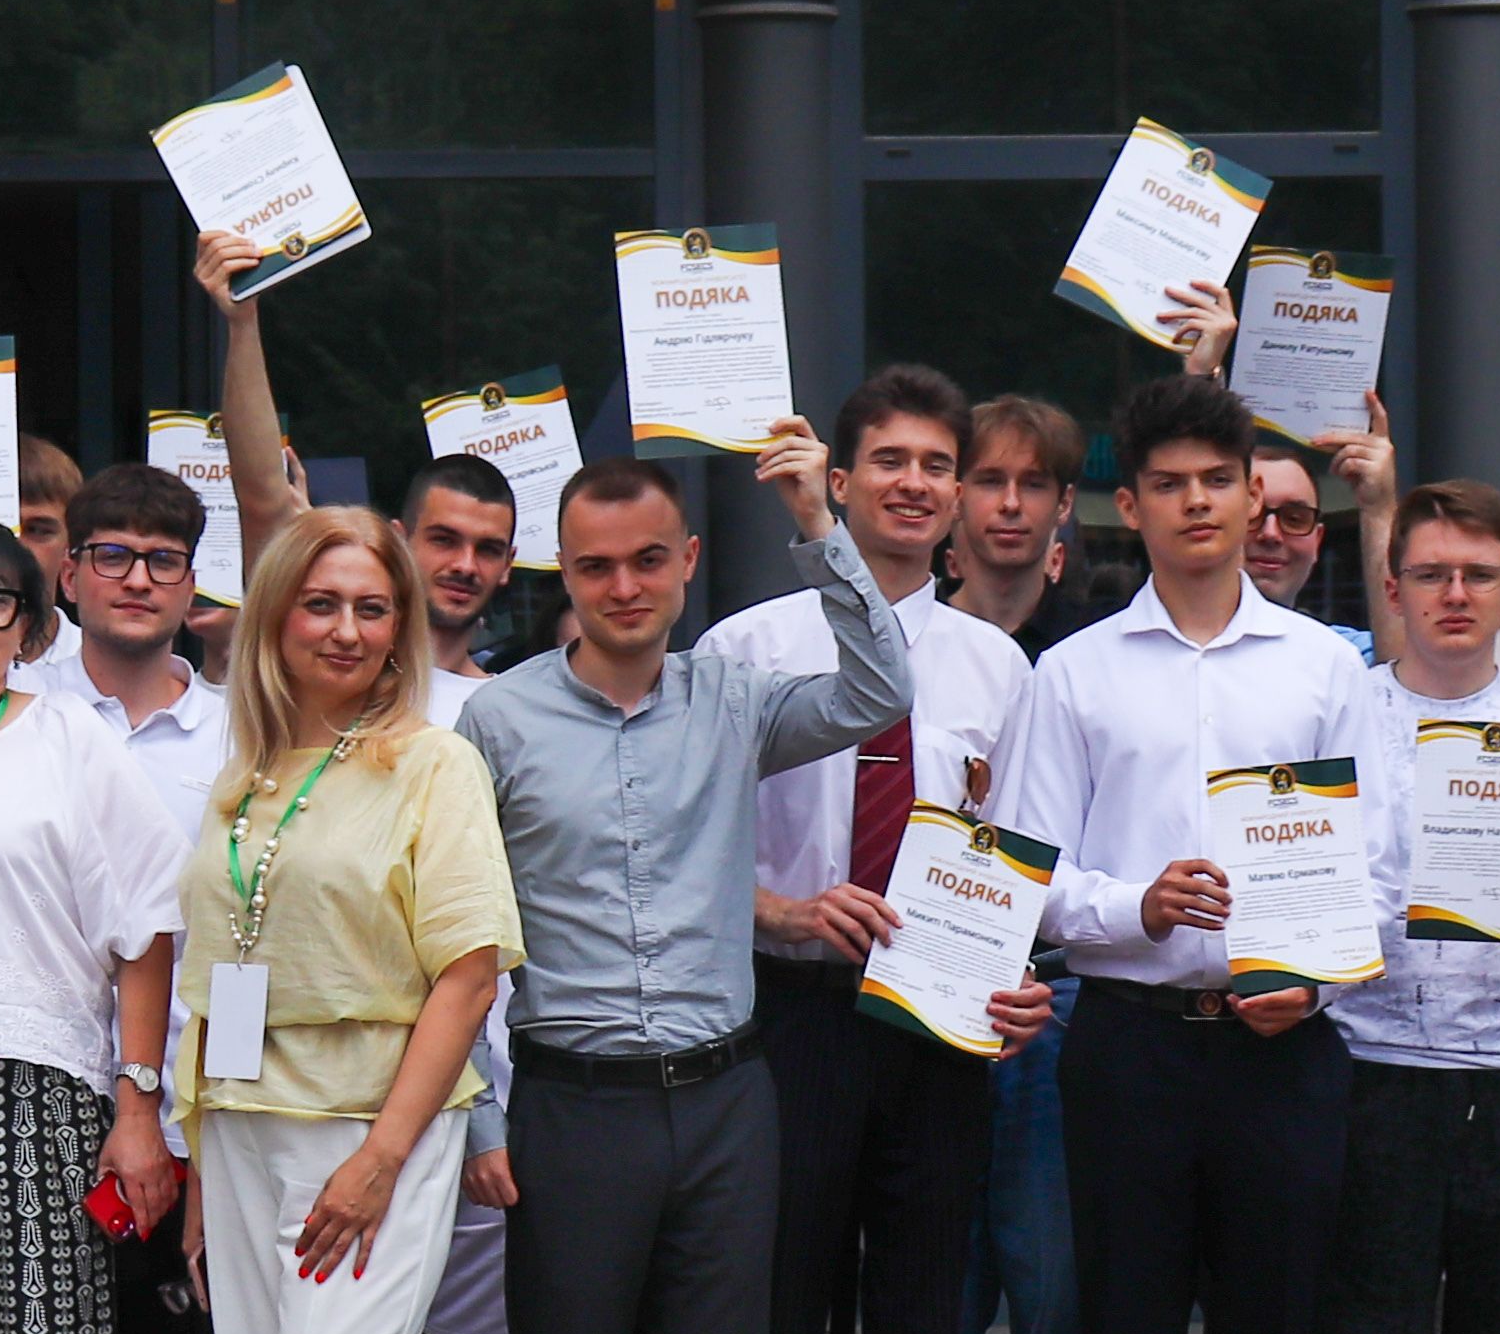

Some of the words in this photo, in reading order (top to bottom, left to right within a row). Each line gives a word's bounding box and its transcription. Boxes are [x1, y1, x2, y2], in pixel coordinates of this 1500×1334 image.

[231, 182, 314, 238] ПОДЯКА
[1140, 176, 1224, 227] ПОДЯКА
[655, 285, 749, 310] ПОДЯКА
[1273, 301, 1359, 323] ПОДЯКА
[179, 464, 231, 482] ПОДЯ
[1244, 817, 1335, 844] ПОДЯКА
[1422, 822, 1485, 836] Владиславу
[924, 865, 1016, 908] ПОДЯКА
[940, 919, 1006, 949] Парамонову
